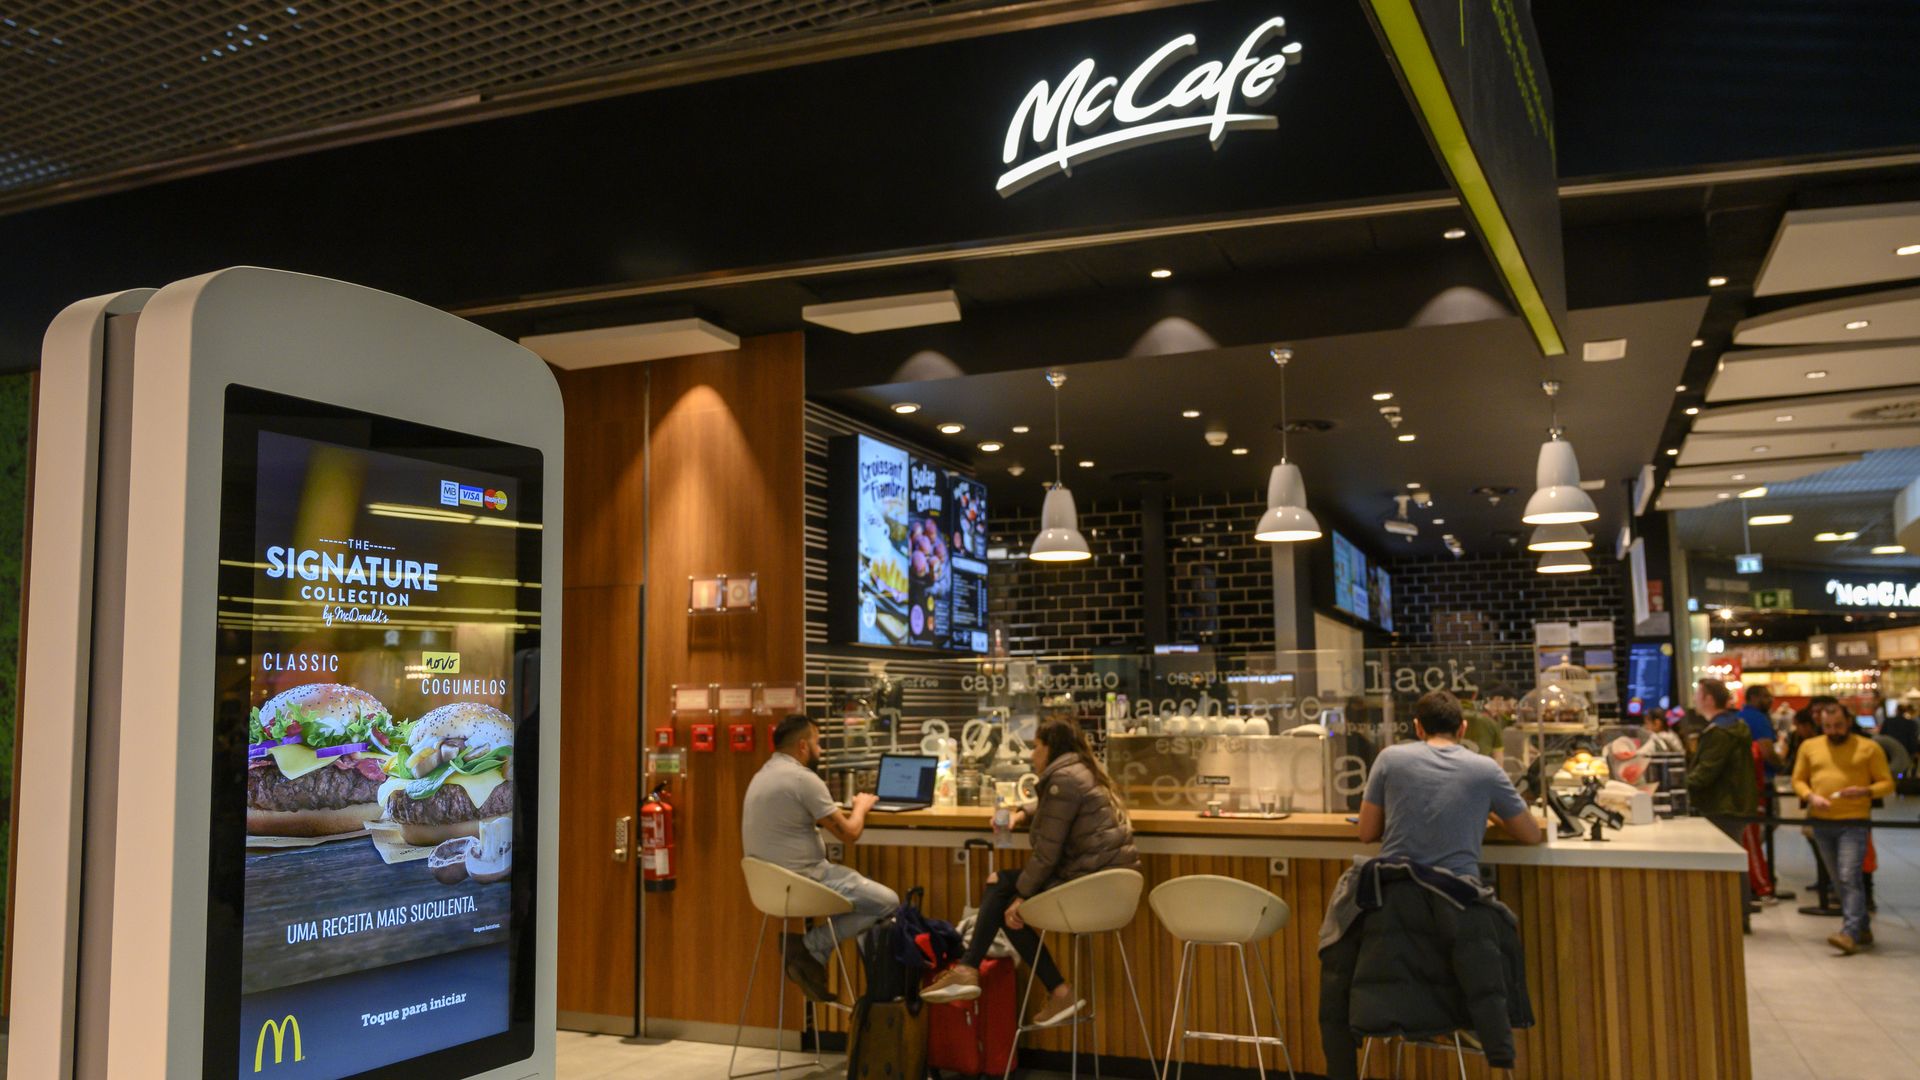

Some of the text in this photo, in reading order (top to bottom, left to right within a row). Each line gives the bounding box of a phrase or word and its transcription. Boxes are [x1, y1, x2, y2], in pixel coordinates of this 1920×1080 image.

[1002, 16, 1303, 170] McCafé
[463, 490, 480, 502] VISA
[348, 538, 370, 551] THE
[266, 545, 438, 592] SIGNATURE
[301, 585, 410, 607] COLLECTION
[322, 604, 390, 627] by McDonald's
[263, 652, 339, 673] CLASSIC
[426, 656, 457, 671] novo
[421, 678, 507, 696] COGUMELOS
[287, 895, 478, 944] UMA RECEITA MAIS SUCULENTA.
[361, 992, 467, 1027] Toque para iniciar
